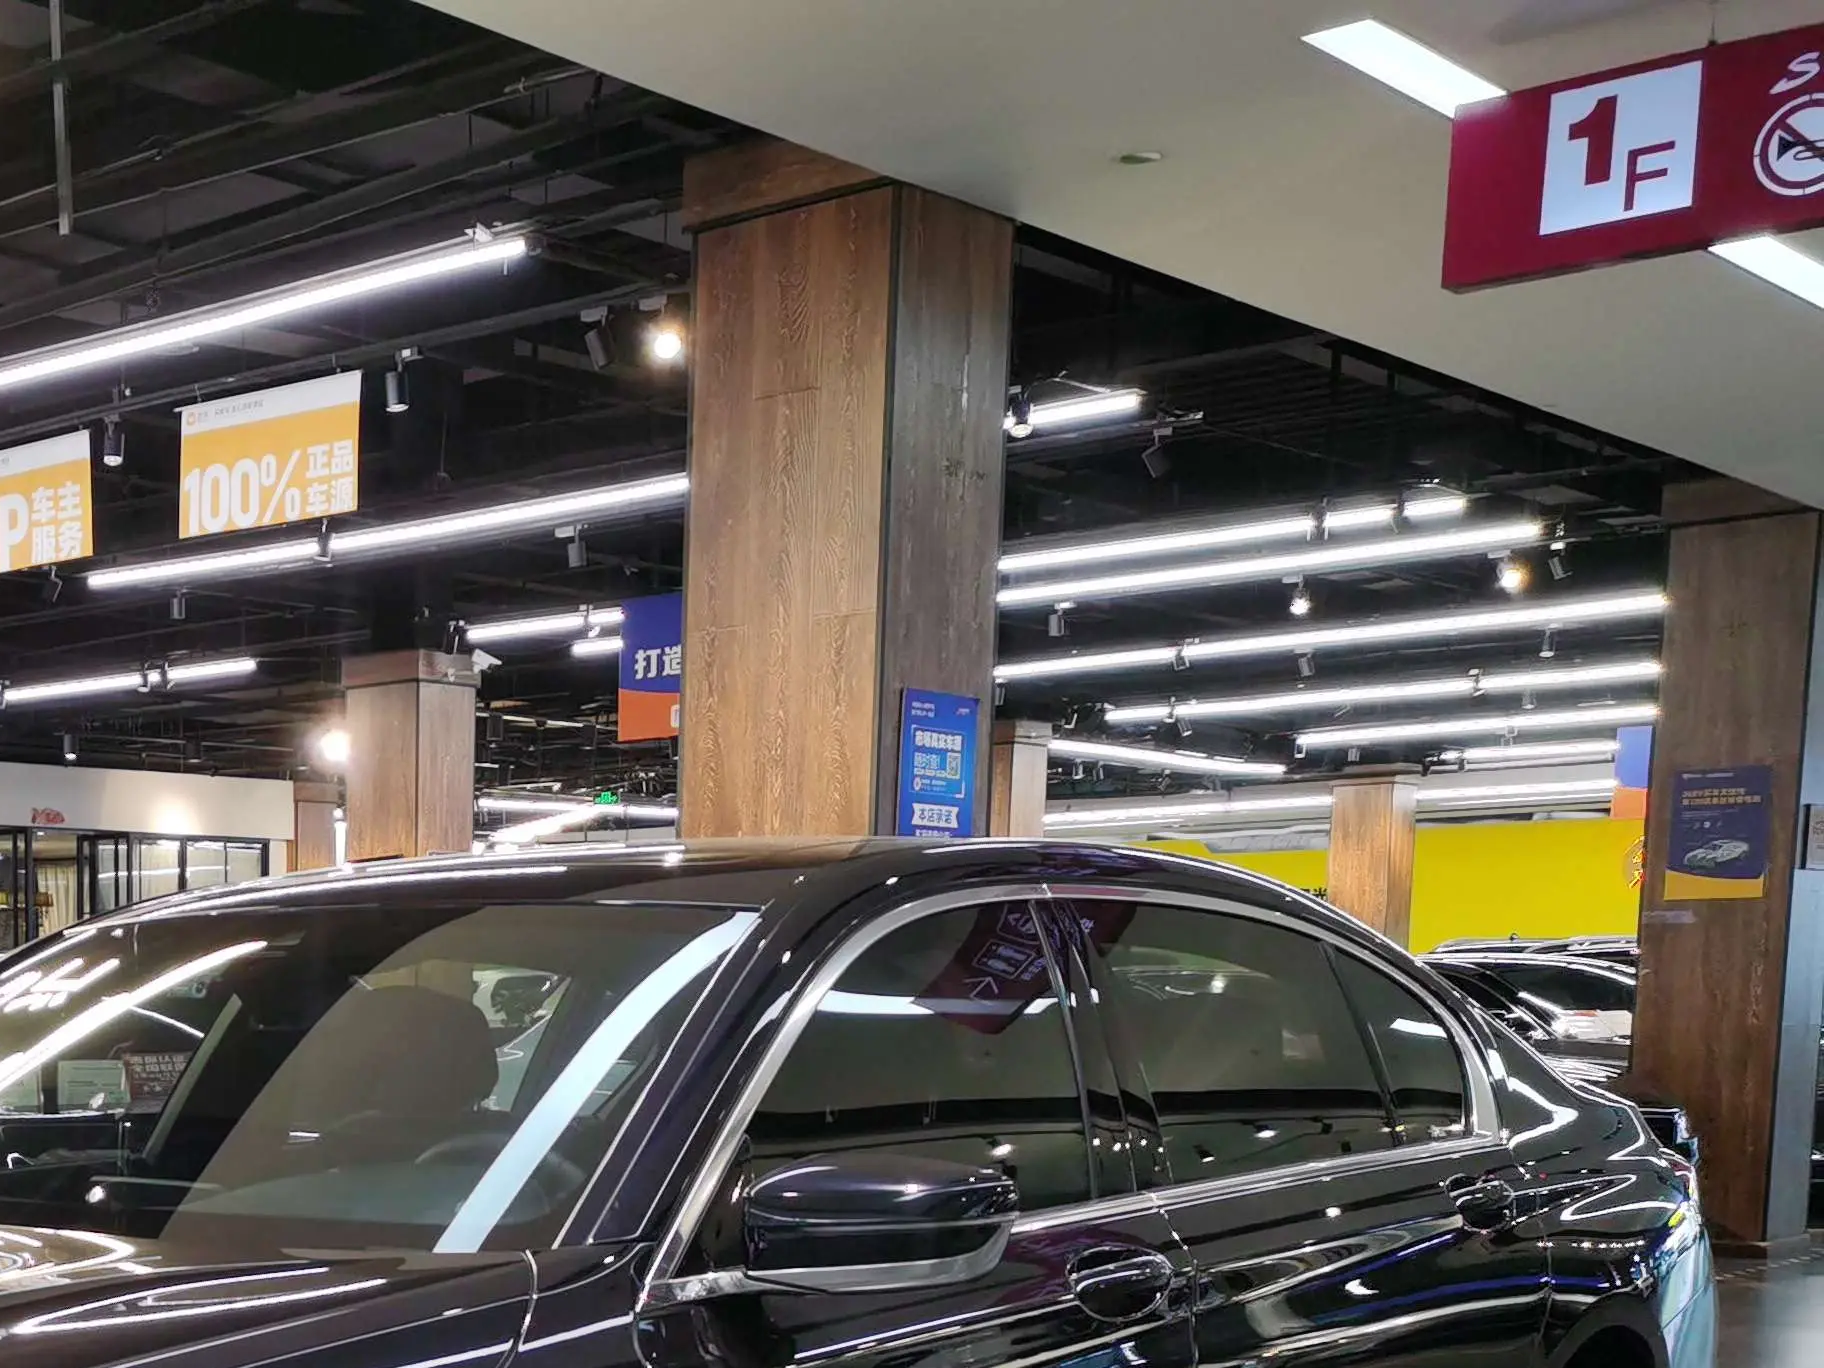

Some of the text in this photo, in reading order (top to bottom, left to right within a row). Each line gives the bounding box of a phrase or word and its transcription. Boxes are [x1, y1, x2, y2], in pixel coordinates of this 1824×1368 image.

[1567, 94, 1676, 212] 1F
[306, 439, 354, 479] 正品
[31, 481, 82, 522] 车主
[184, 448, 301, 536] 100%
[306, 476, 354, 517] 车源
[32, 520, 83, 565] 服务
